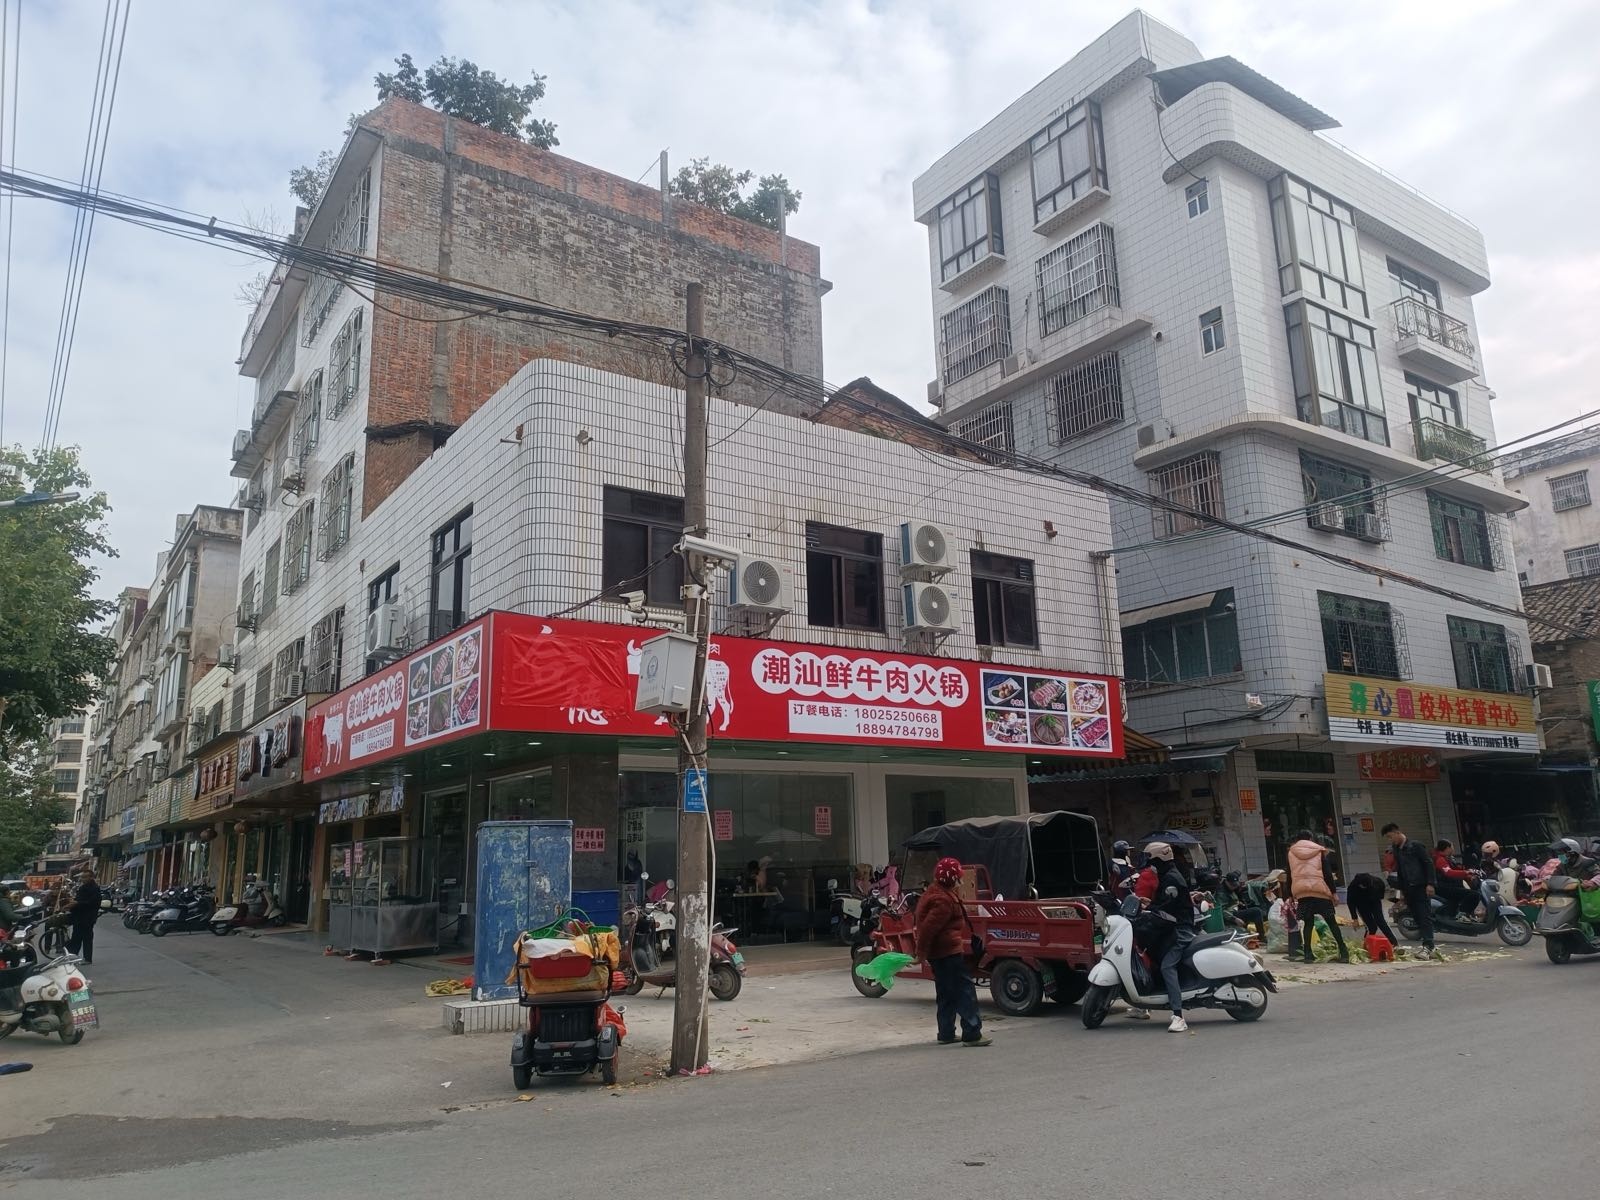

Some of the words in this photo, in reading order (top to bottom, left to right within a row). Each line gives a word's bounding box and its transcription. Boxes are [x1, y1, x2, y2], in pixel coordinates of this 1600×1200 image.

[762, 654, 963, 699] 潮汕鲜牛肉火锅
[854, 708, 938, 724] 18025250668
[855, 723, 939, 739] 18894784798
